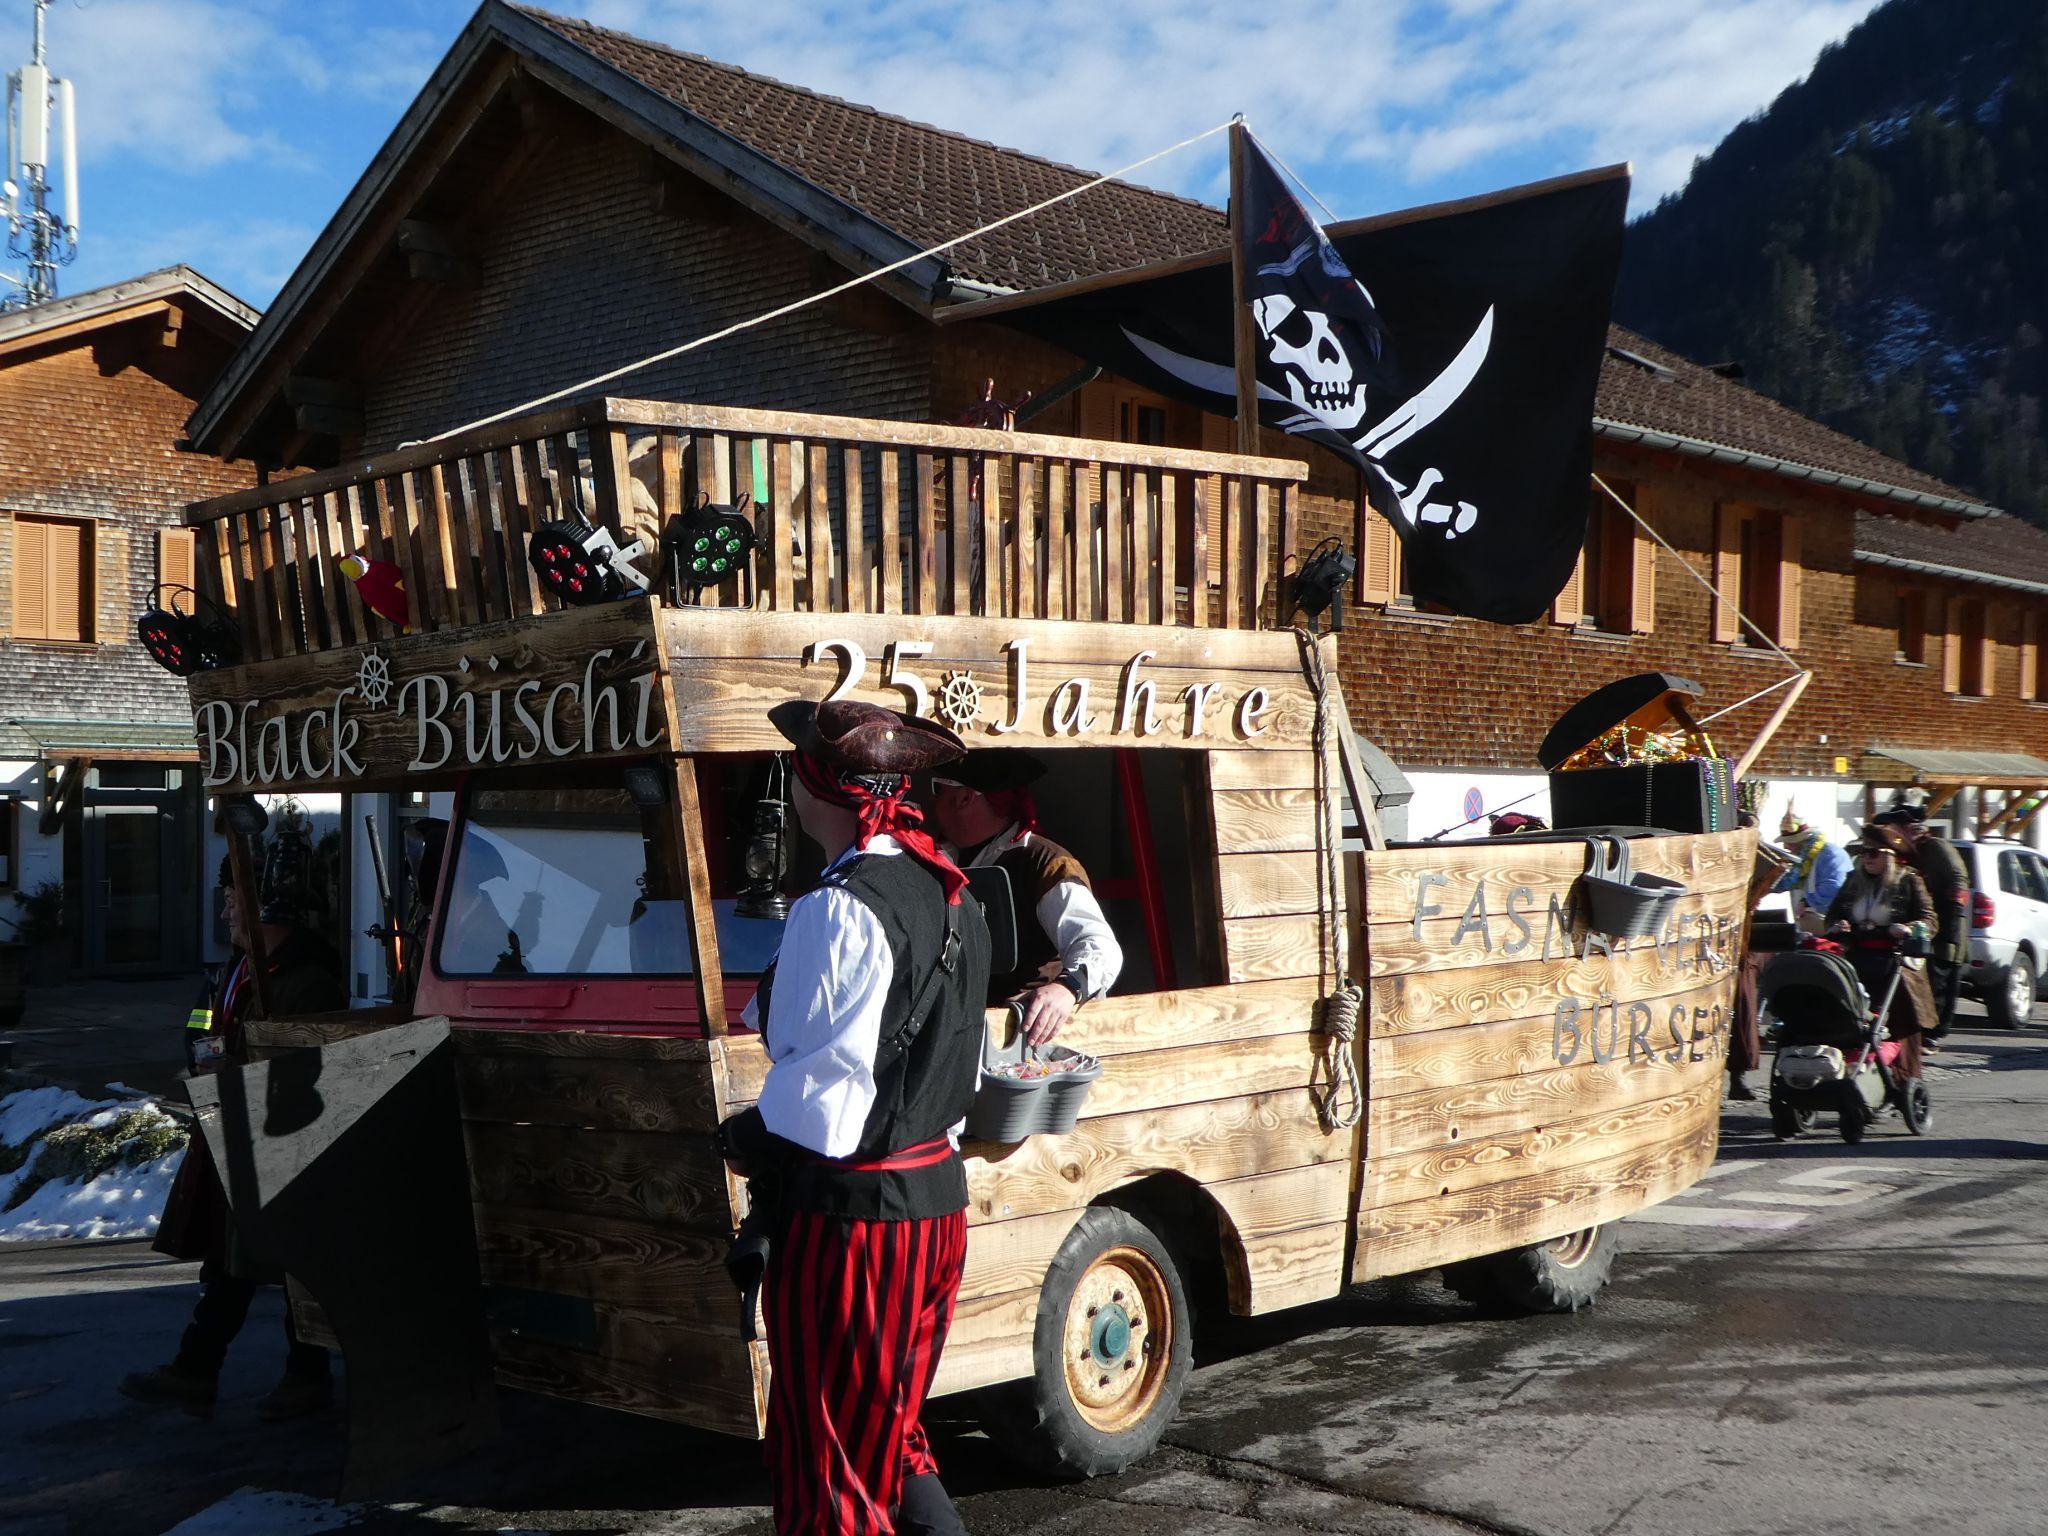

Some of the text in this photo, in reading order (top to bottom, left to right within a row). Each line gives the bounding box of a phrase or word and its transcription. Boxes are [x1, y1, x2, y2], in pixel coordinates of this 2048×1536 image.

[195, 686, 368, 787] Black
[811, 636, 1271, 738] 25 Jahre
